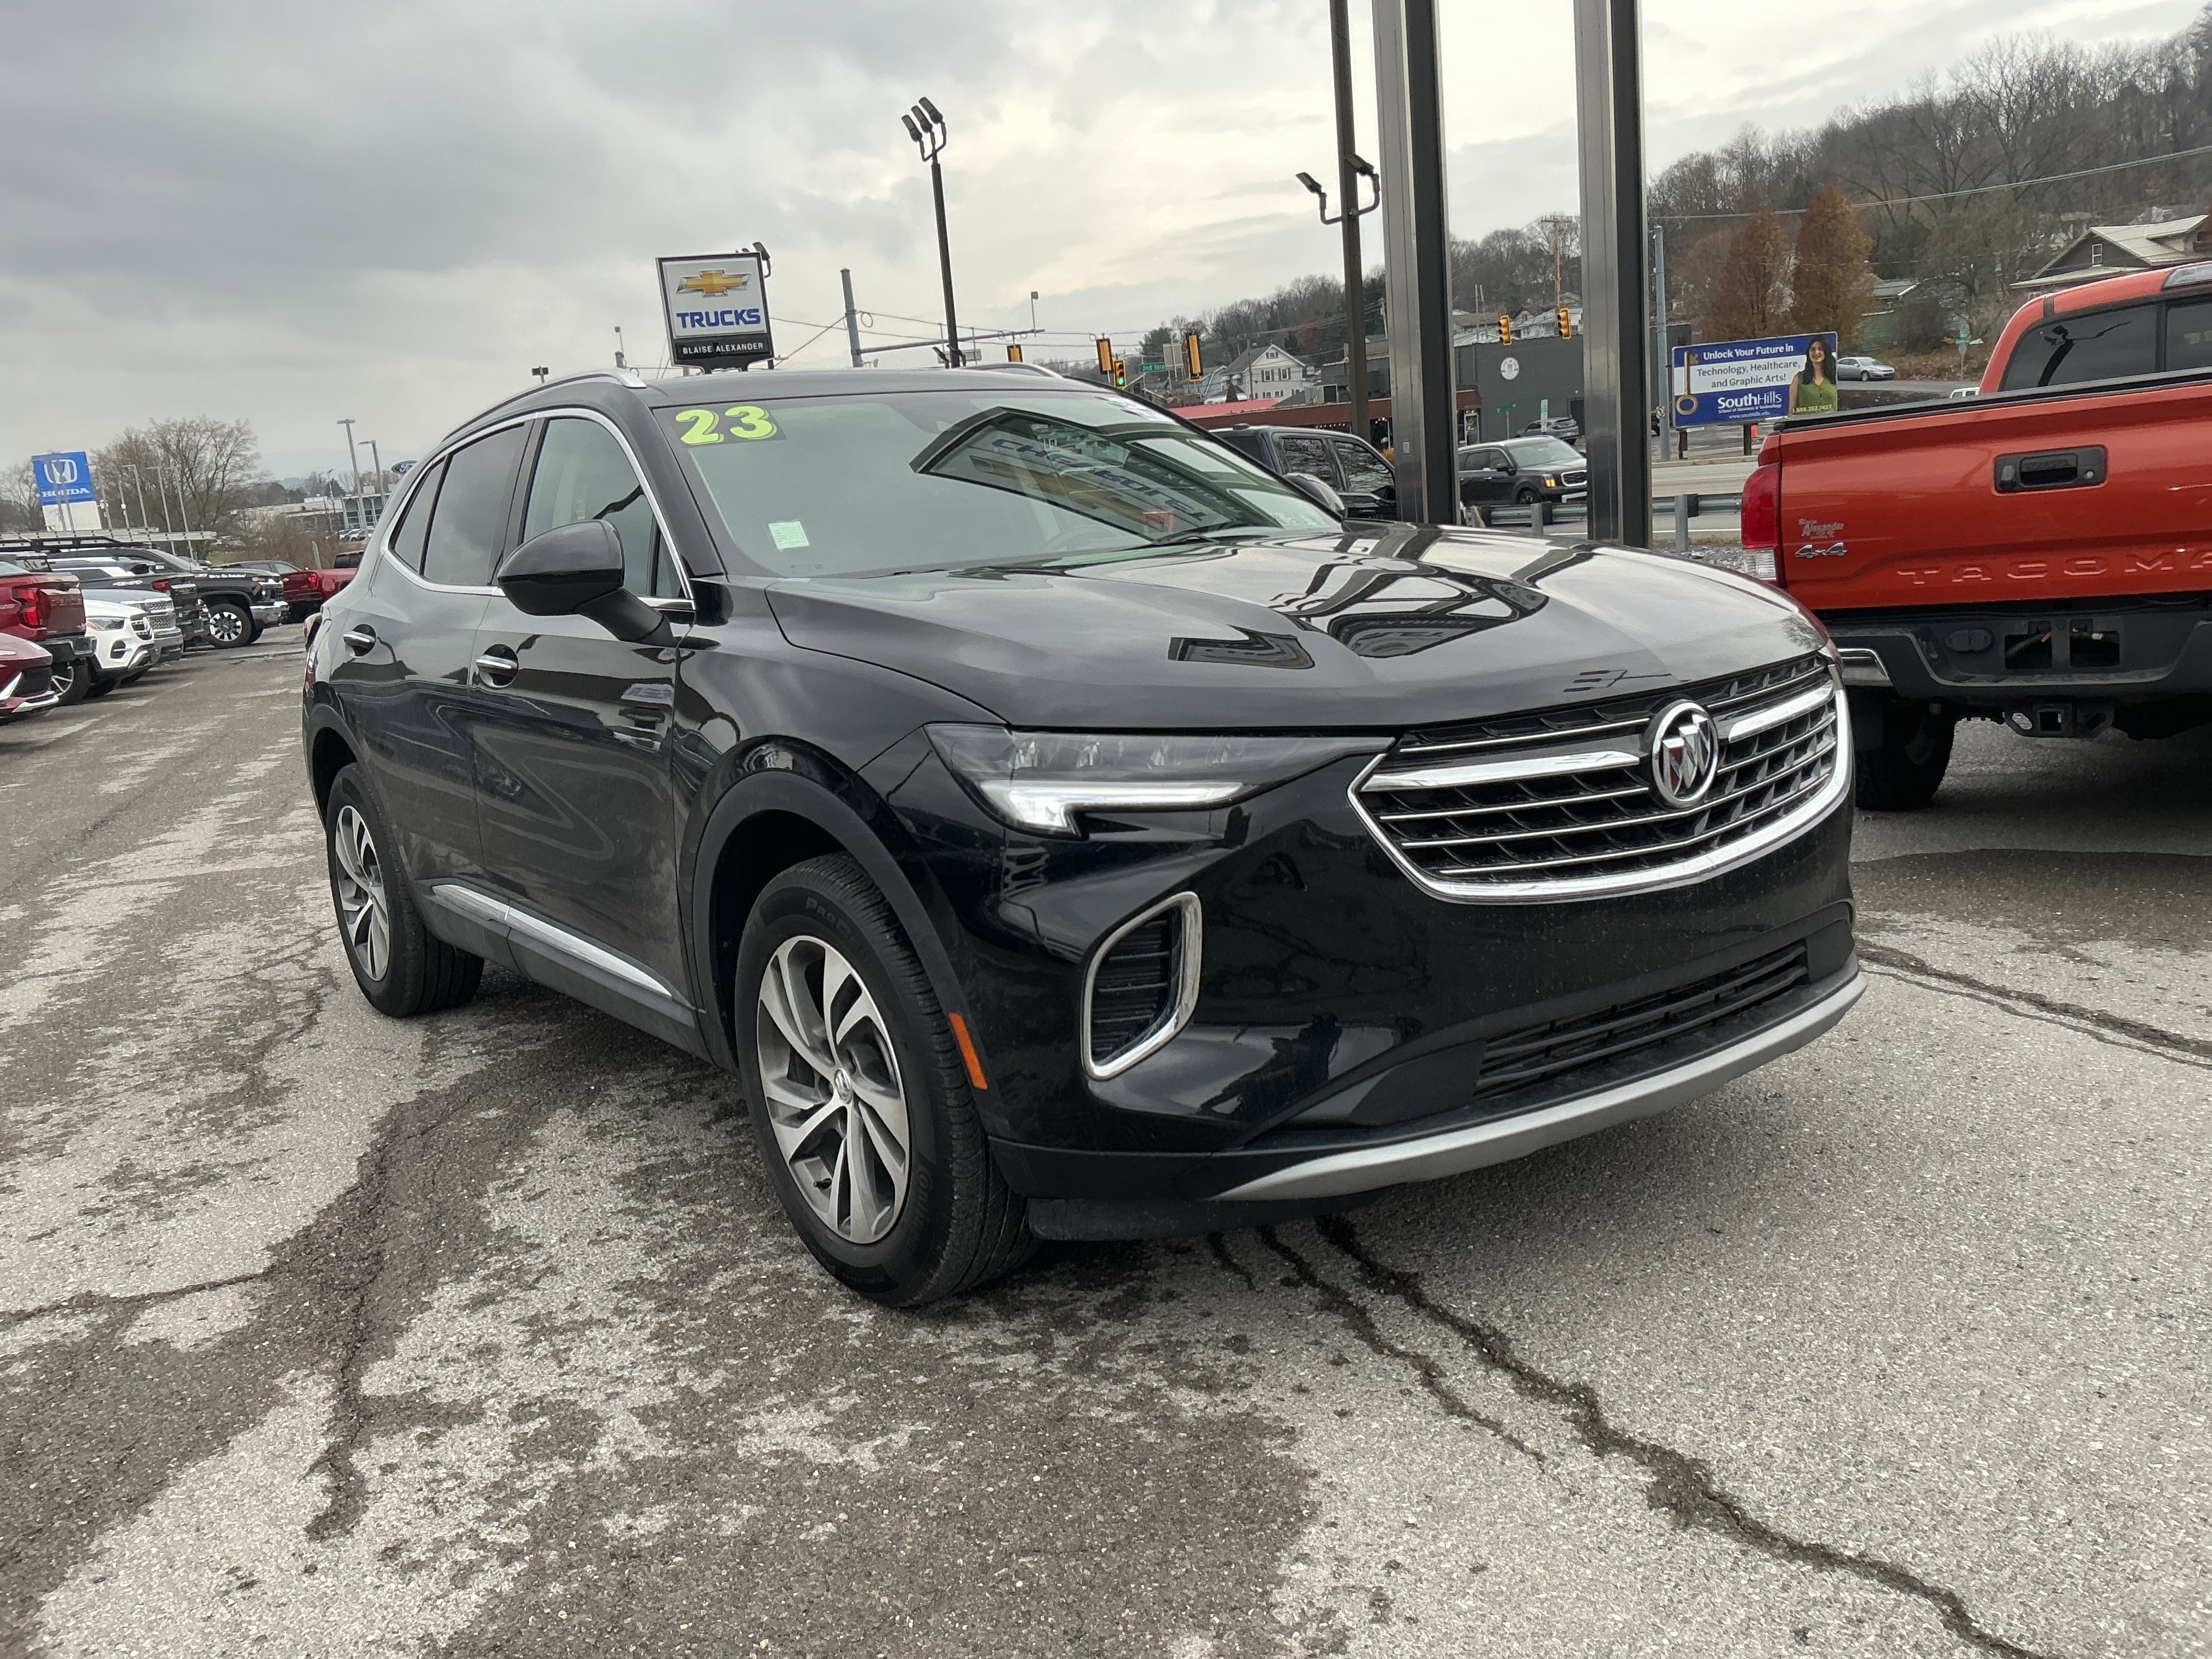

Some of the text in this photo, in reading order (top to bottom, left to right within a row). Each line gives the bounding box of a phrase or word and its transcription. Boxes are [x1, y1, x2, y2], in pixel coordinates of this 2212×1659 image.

[676, 308, 761, 328] TRUCKS
[682, 342, 764, 354] BLAISE ALEXANDER
[1703, 343, 1793, 360] Unlock Your Future in
[1697, 361, 1801, 377] Technology, Healthcare,
[1711, 373, 1786, 388] and Graphic Arts!
[675, 405, 777, 445] 23
[41, 488, 91, 497] HONDA
